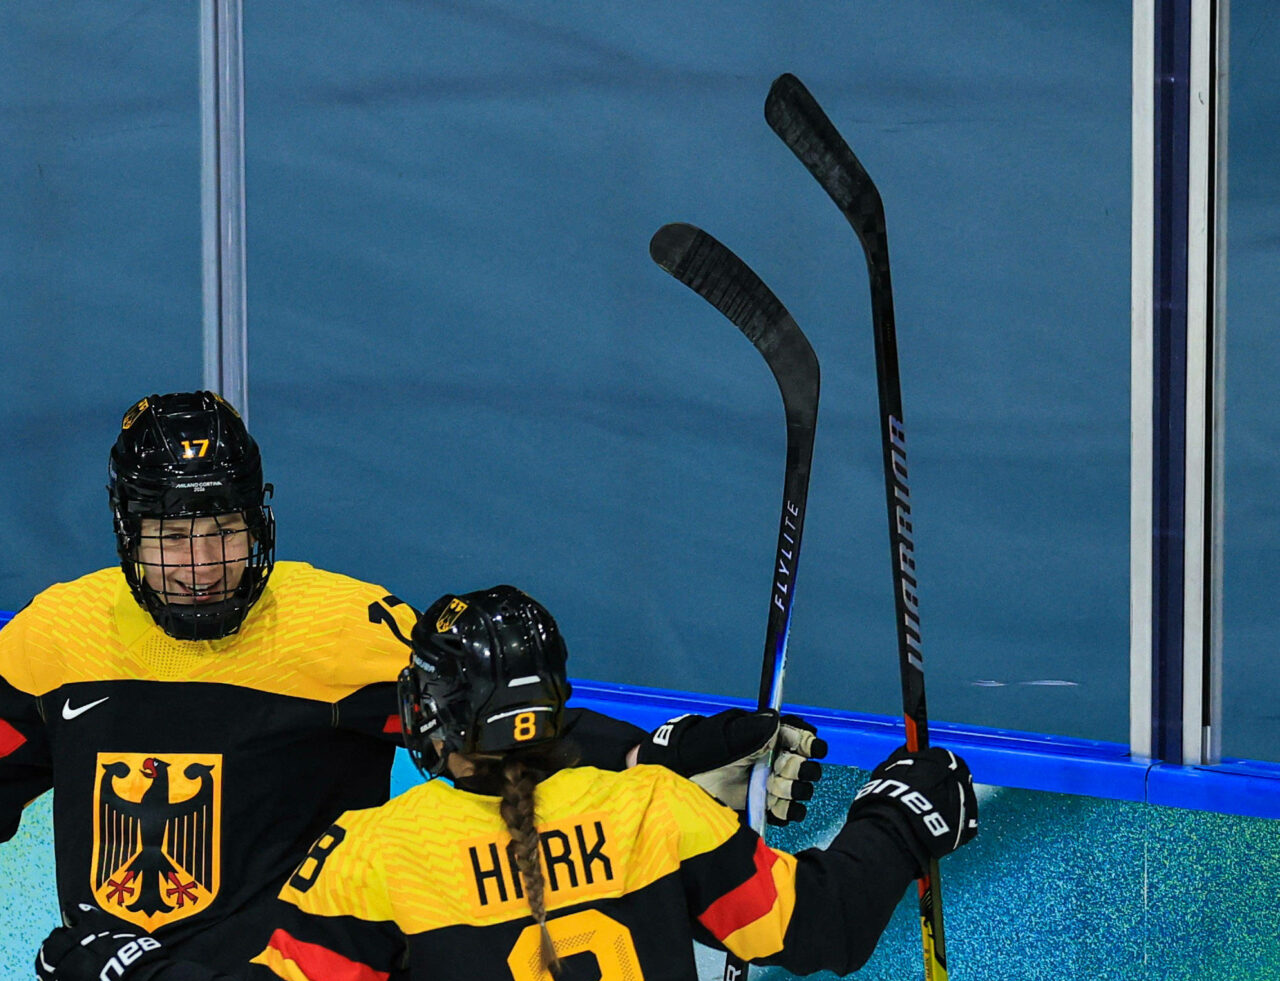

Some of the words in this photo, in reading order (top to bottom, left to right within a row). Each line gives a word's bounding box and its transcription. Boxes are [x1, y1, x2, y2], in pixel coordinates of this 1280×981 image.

[181, 439, 210, 459] 17
[774, 500, 799, 612] FLYLITE
[888, 414, 924, 673] WARRIOR
[513, 712, 537, 742] 8
[289, 823, 347, 894] 8
